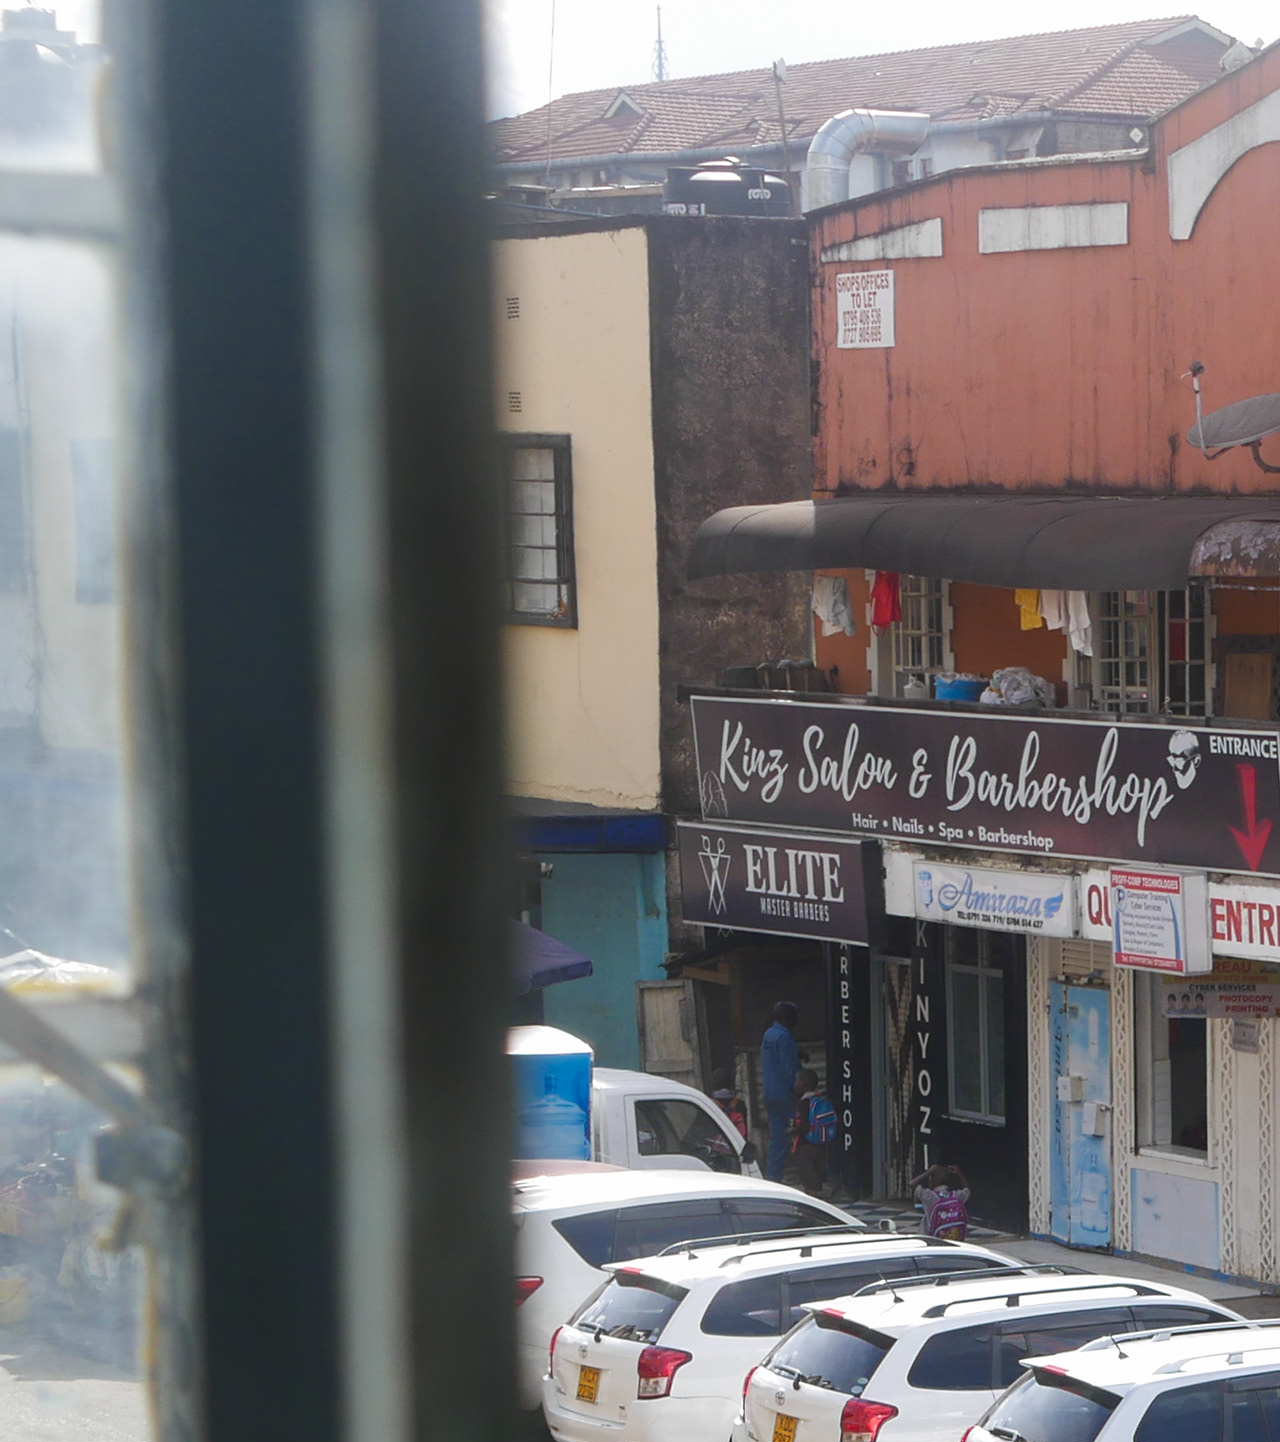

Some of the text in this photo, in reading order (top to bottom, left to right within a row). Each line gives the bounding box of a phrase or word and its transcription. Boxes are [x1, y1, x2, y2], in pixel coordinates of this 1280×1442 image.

[837, 276, 860, 293] SHOPS
[851, 291, 877, 309] TO LET
[1210, 736, 1278, 759] ENTRANCE
[720, 719, 1174, 848] Kinz Salon & Barbershop
[852, 812, 1054, 852] Hair Nails Spa Barbershop
[743, 844, 844, 903] ELITE
[760, 897, 830, 922] MASTER BARBERS
[1217, 984, 1256, 992] SERVICES
[1219, 995, 1273, 1003] PHOTOCOPY
[1225, 1005, 1268, 1013] PRINTING
